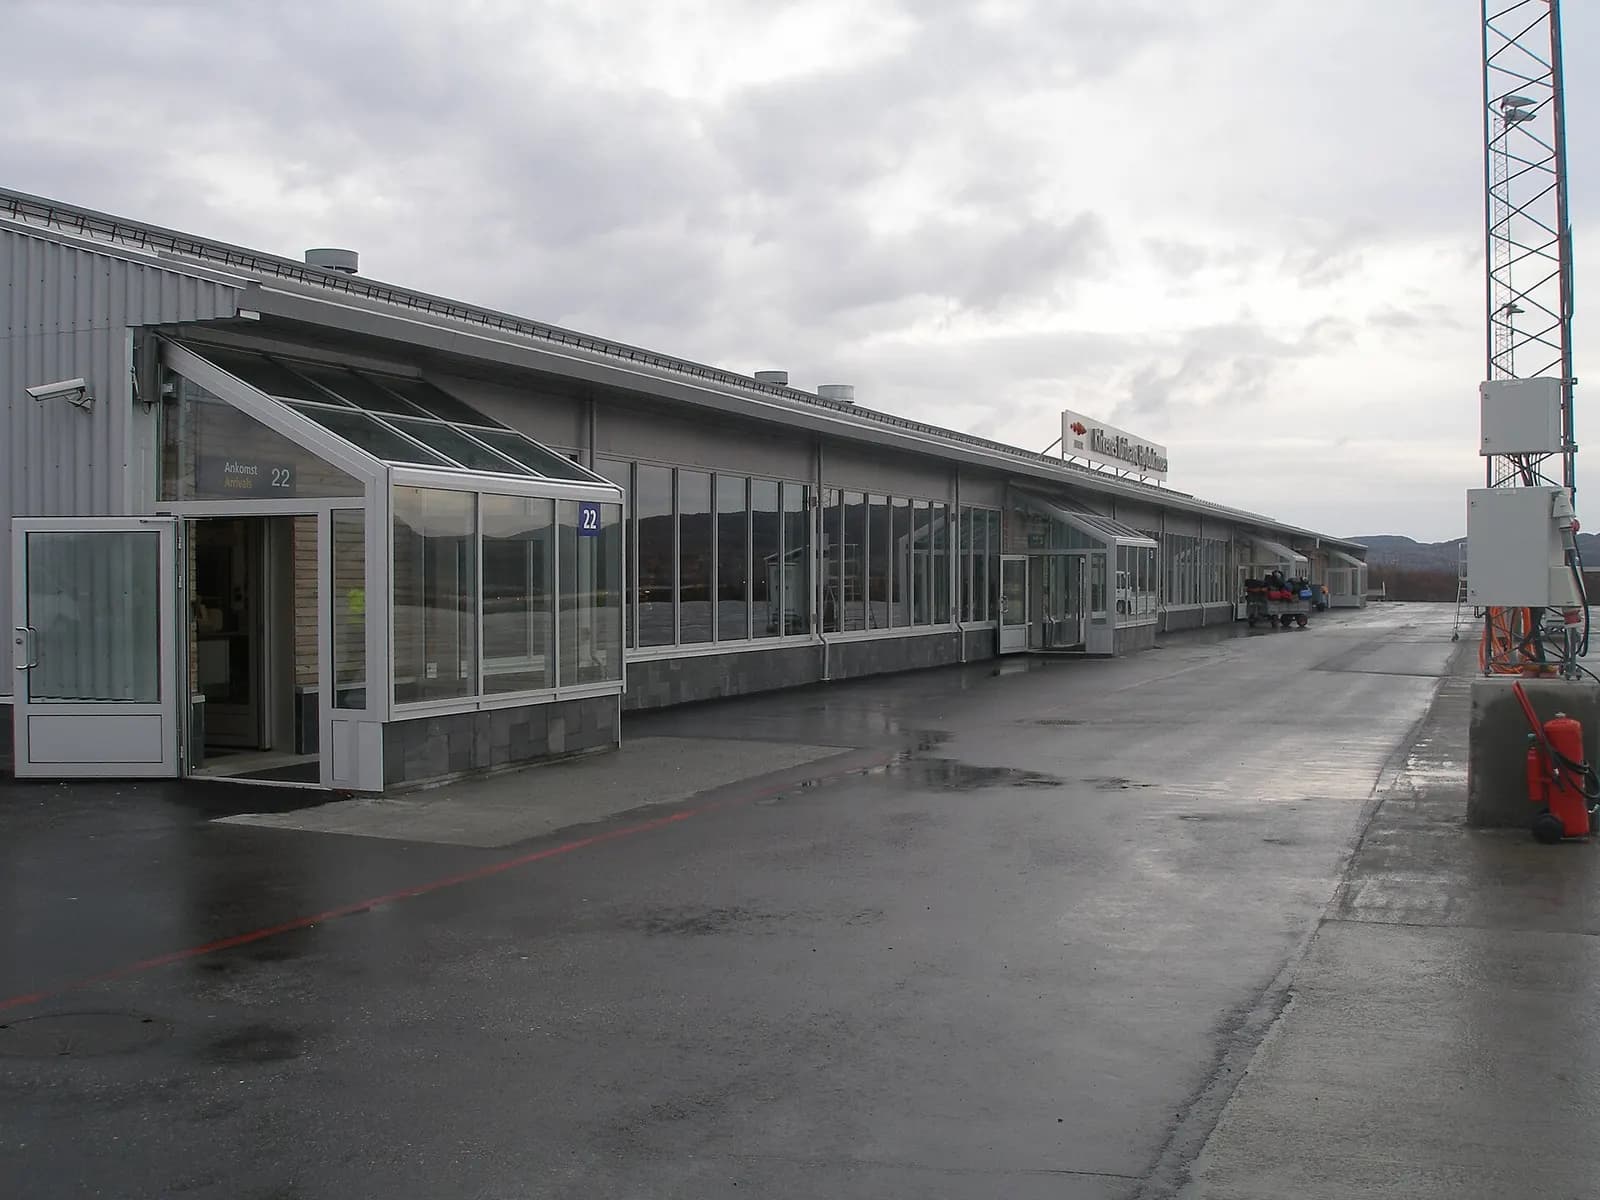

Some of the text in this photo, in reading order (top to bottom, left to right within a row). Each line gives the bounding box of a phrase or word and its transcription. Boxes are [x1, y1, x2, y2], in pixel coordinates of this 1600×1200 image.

[224, 461, 258, 475] Ankomst
[271, 467, 290, 487] 22
[583, 509, 597, 529] 22
